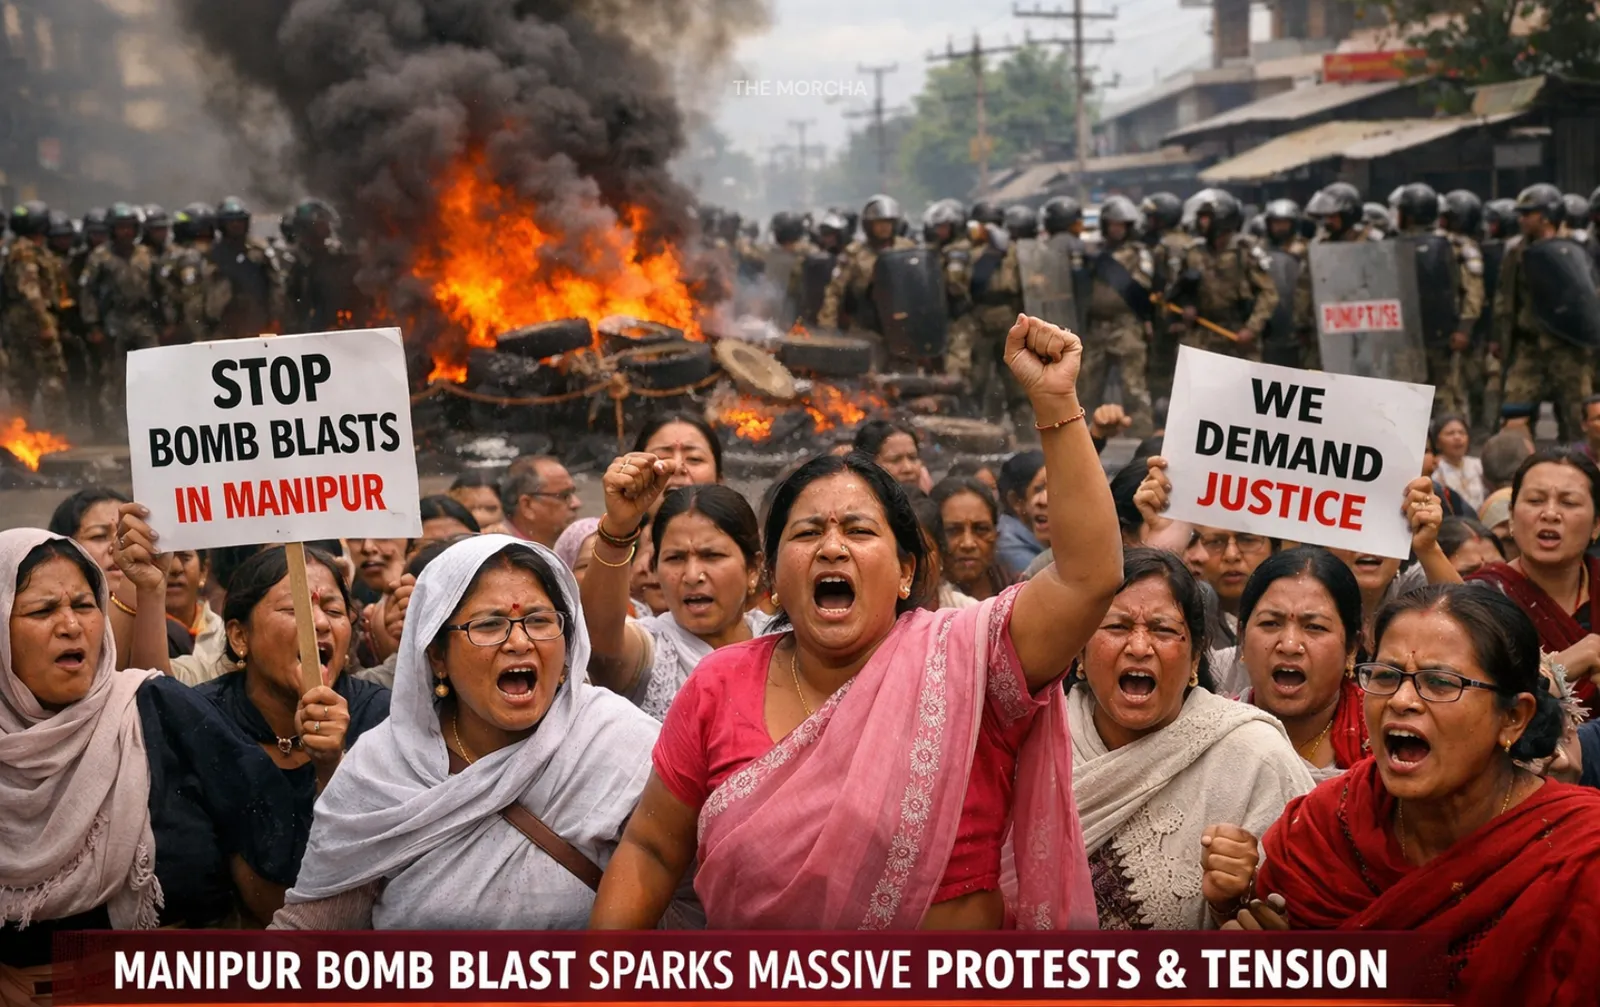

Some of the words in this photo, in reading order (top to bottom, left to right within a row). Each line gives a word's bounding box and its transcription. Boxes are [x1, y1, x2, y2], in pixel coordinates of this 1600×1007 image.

[212, 354, 331, 409] STOP
[1251, 378, 1326, 424] WE
[149, 422, 259, 467] BOMB
[270, 412, 400, 459] BLASTS
[1195, 419, 1383, 482] DEMAND
[175, 486, 213, 523] IN
[223, 473, 387, 519] MANIPUR
[1197, 472, 1367, 531] JUSTICE
